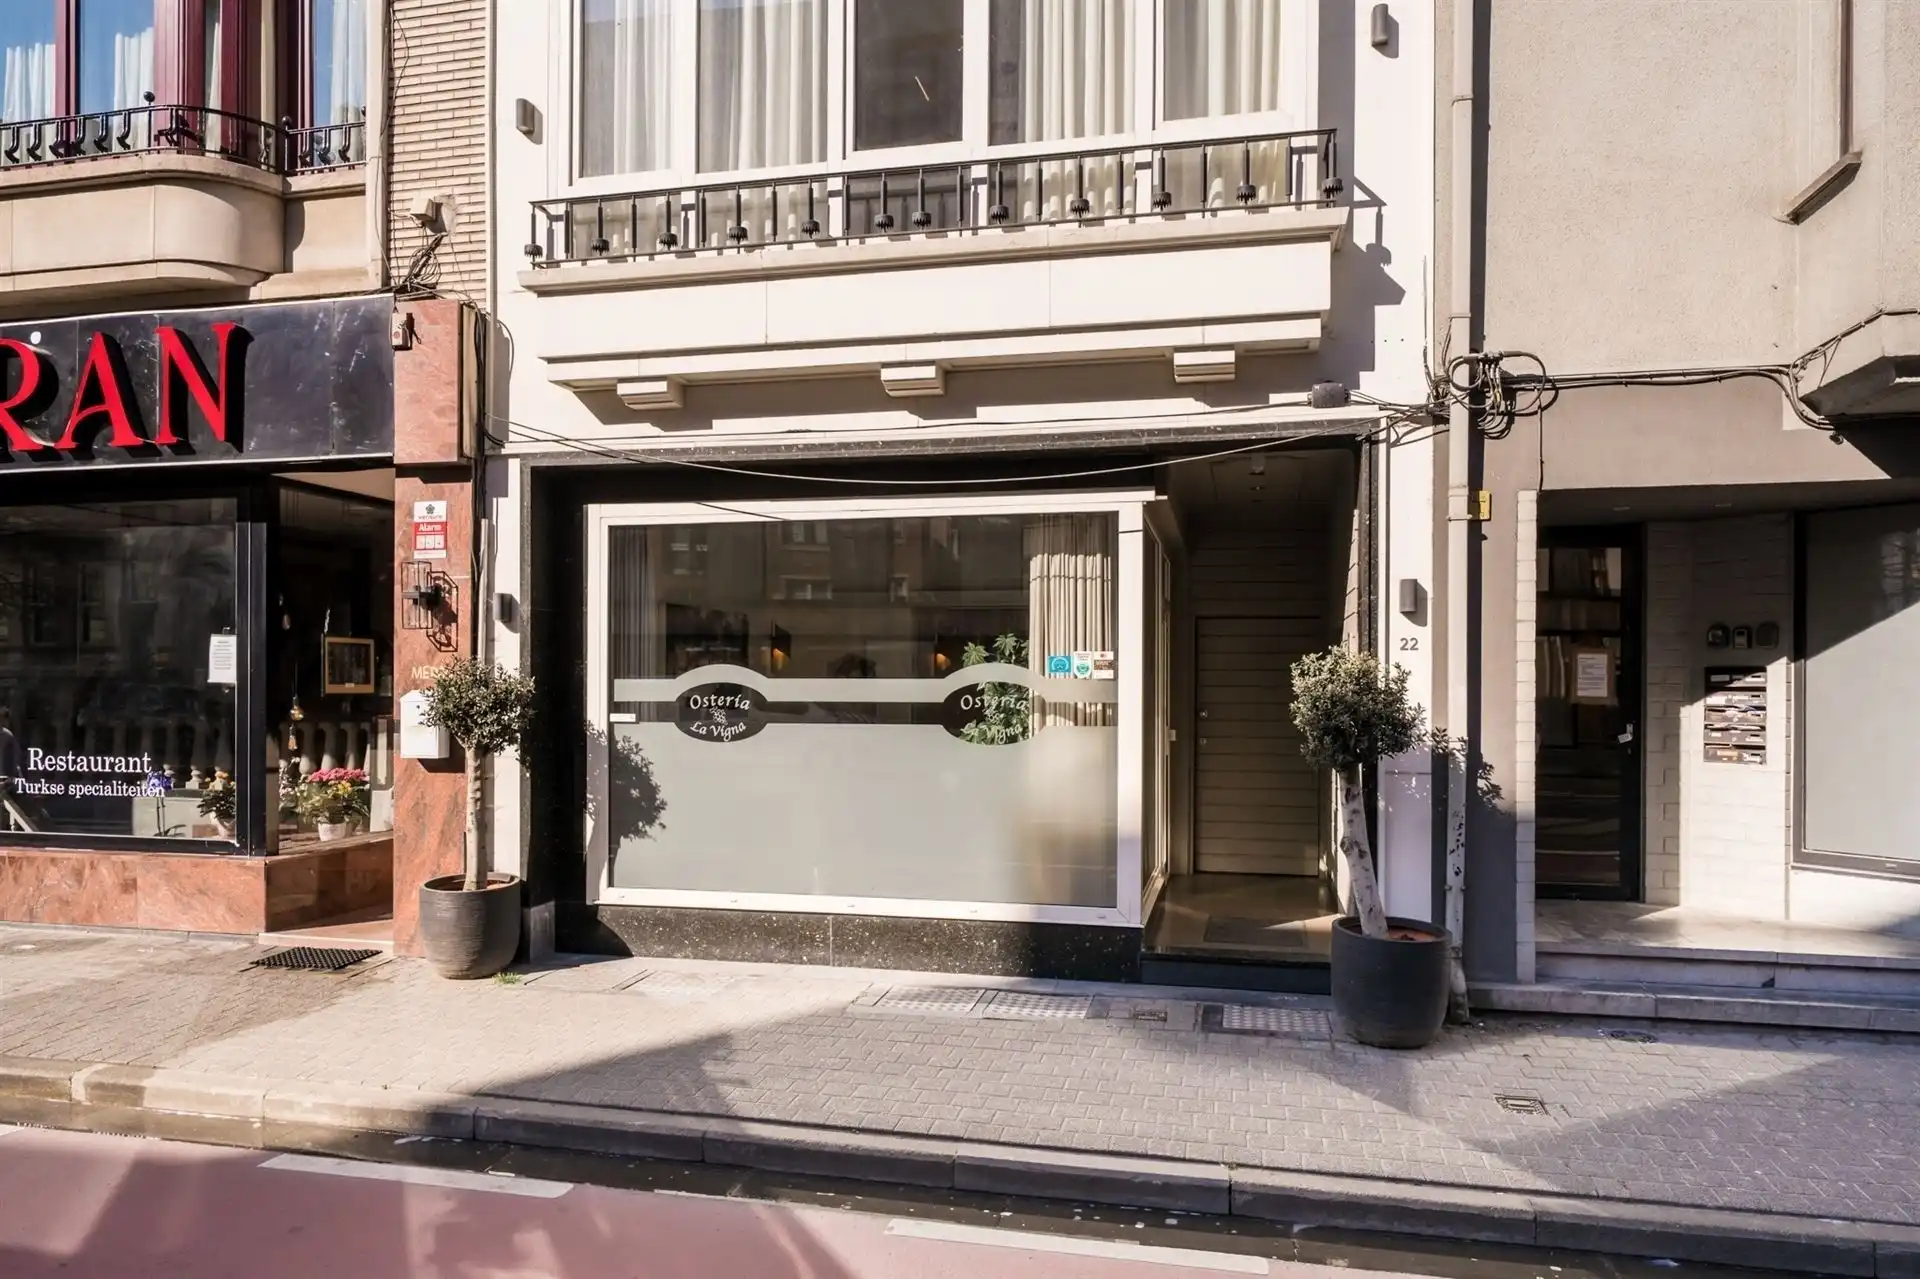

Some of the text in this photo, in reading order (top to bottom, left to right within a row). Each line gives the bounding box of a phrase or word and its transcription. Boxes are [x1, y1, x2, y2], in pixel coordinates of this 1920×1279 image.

[418, 523, 442, 532] Alarm
[1400, 637, 1419, 651] 22
[689, 694, 751, 710] Osteria
[690, 721, 747, 742] La Vigna
[27, 747, 152, 773] Restaurant
[15, 777, 165, 799] Turkse specialiteiten
